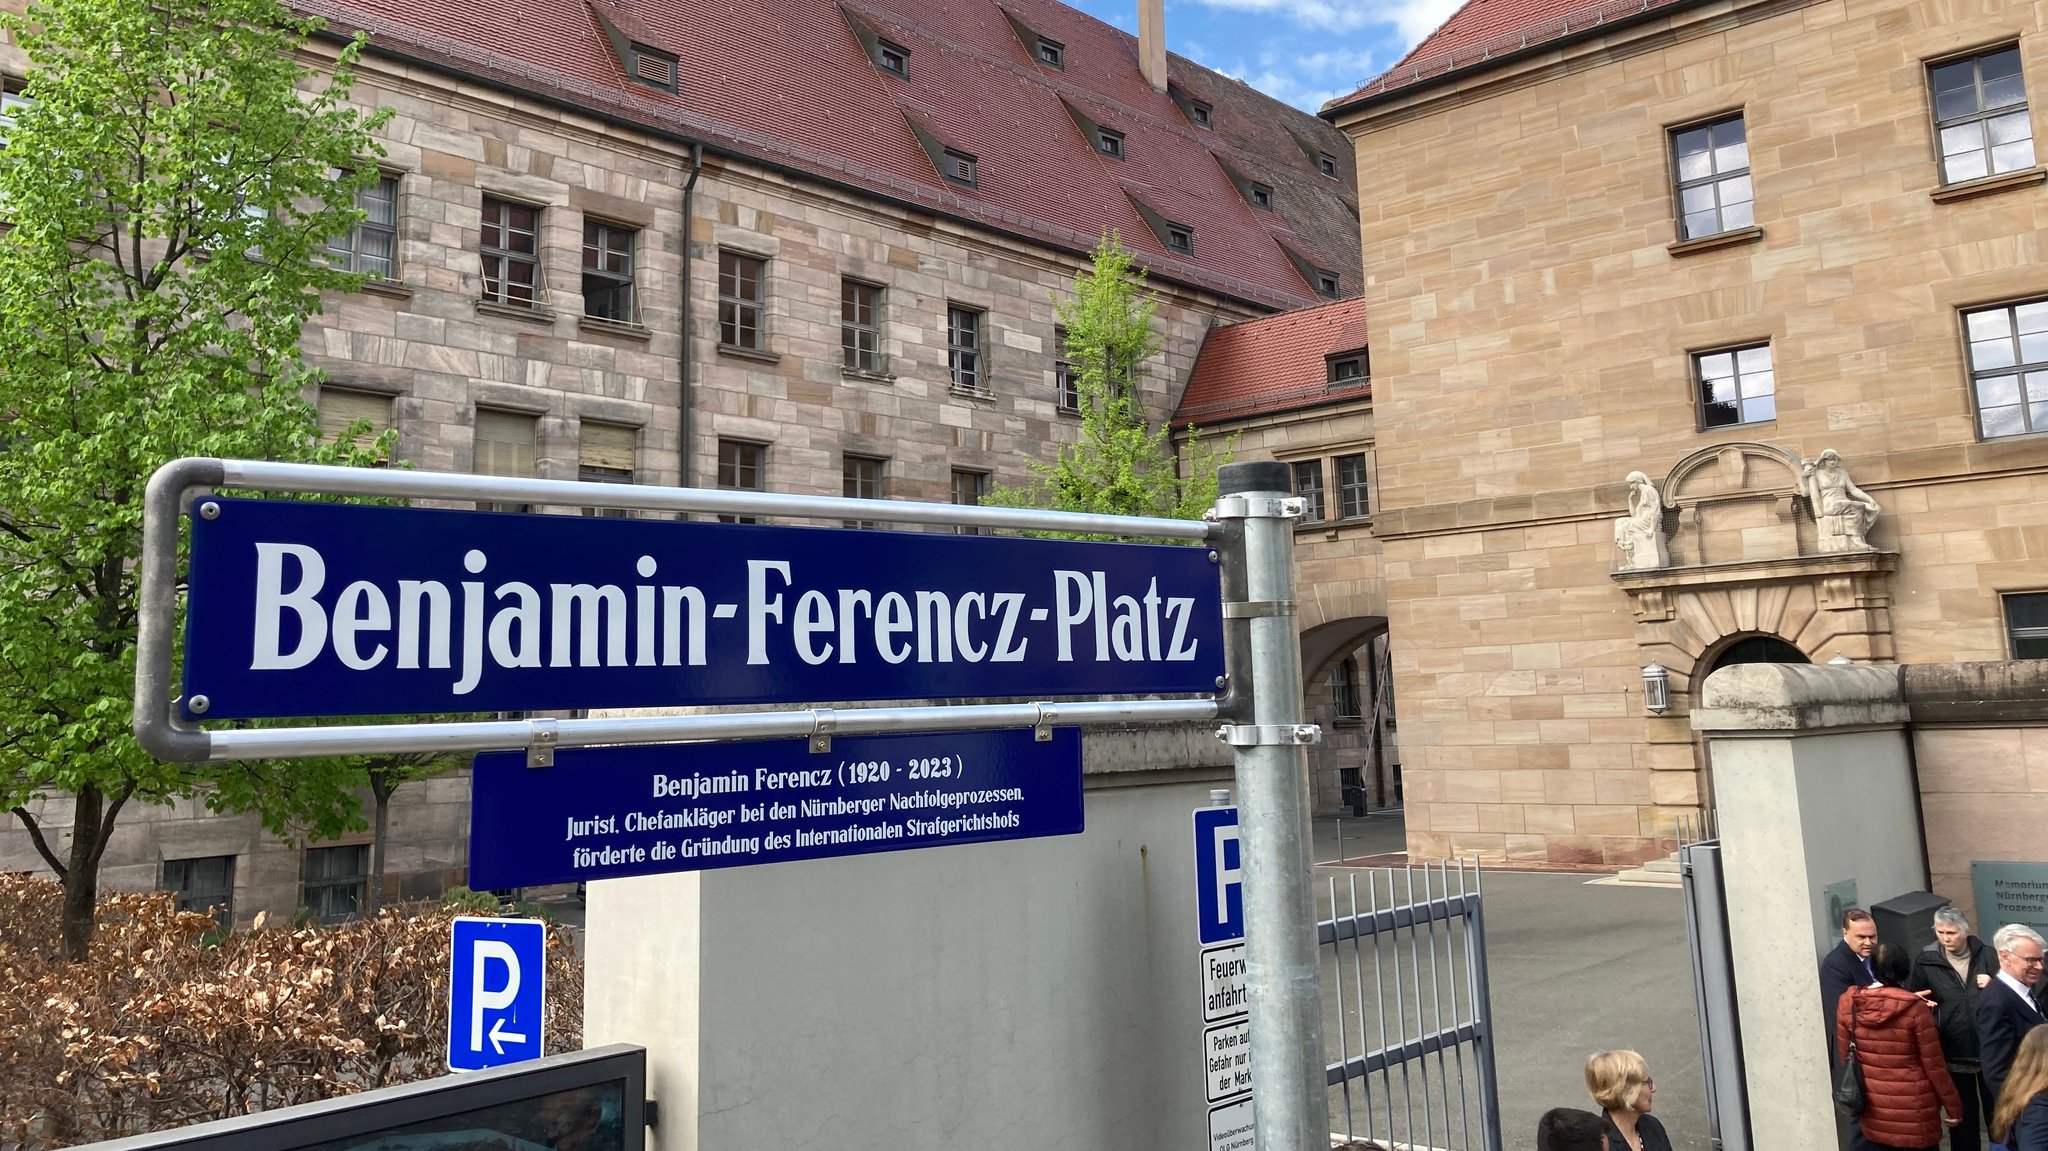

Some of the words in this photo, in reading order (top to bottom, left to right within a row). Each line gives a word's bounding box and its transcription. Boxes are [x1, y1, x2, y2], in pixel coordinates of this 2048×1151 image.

[249, 542, 1199, 696] Benjamin-Ferencz-Platz
[652, 769, 749, 799] Benjamin
[755, 767, 833, 791] Ferencz
[624, 807, 736, 832] Chefankläger
[740, 802, 765, 823] bei
[768, 801, 797, 820] den
[800, 797, 886, 818] Nürnberger
[572, 844, 646, 869] förderte
[650, 840, 677, 861] die
[680, 835, 760, 858] Gründung
[764, 831, 792, 850] des
[795, 821, 903, 848] Internationalen
[906, 810, 1020, 837] Strafgerichtshofs
[1997, 902, 2044, 912] Prozesse
[471, 940, 521, 1052] P
[1213, 1034, 1238, 1051] Parken
[1209, 1054, 1232, 1073] Gefahr
[1235, 1052, 1247, 1066] nur
[1219, 1075, 1232, 1091] der
